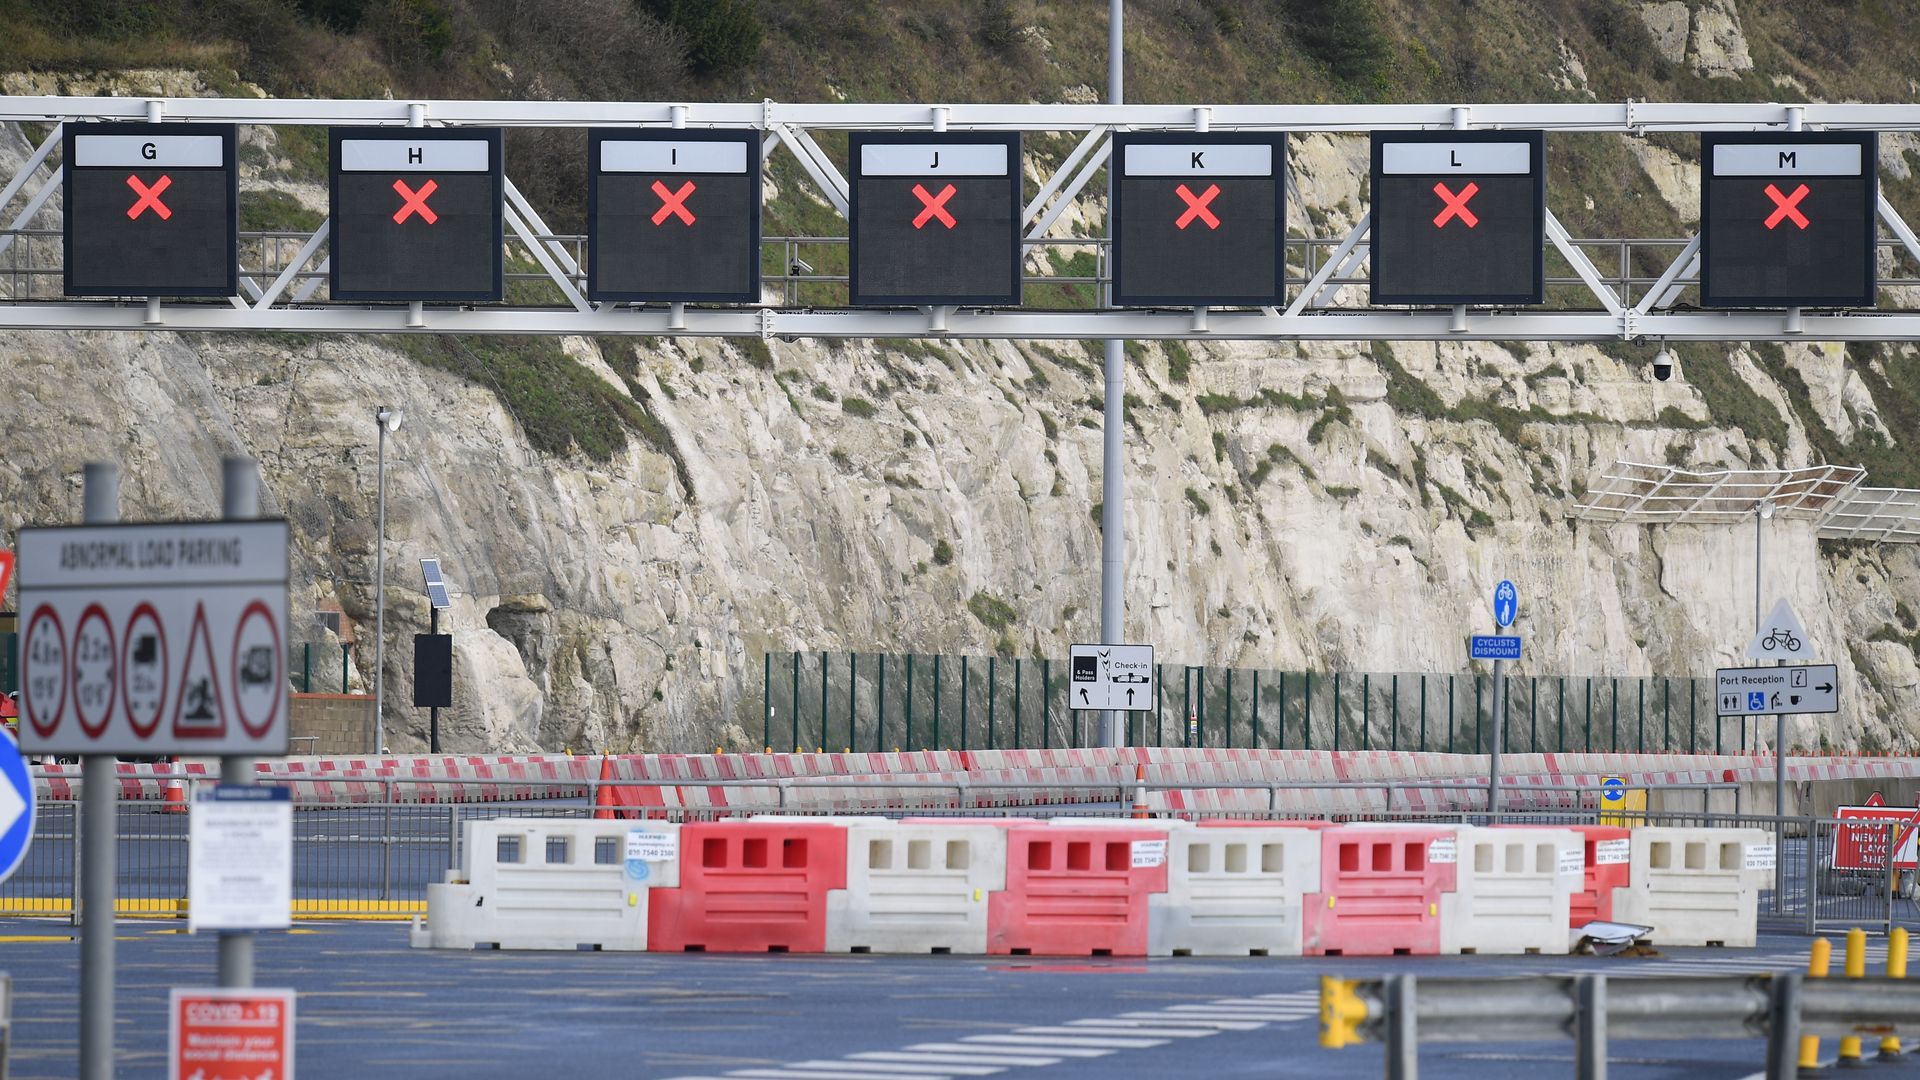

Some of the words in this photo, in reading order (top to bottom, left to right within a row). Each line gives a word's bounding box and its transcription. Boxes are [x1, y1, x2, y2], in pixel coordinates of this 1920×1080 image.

[141, 142, 157, 160] G
[408, 147, 423, 164] H
[672, 148, 676, 166] I
[930, 151, 939, 169] J
[1191, 151, 1205, 169] K
[1450, 150, 1462, 167] L
[1778, 151, 1796, 169] M
[61, 541, 134, 569] ABNORMAL
[138, 540, 173, 568] LOAD
[179, 537, 241, 567] PARKING
[1474, 647, 1519, 655] DISMOUNT
[1477, 639, 1516, 647] CYCLISTS
[1114, 661, 1148, 669] Check-in
[1720, 677, 1738, 685] Port
[1741, 675, 1785, 685] Reception
[186, 1002, 243, 1020] COVID
[258, 1002, 278, 1020] 19
